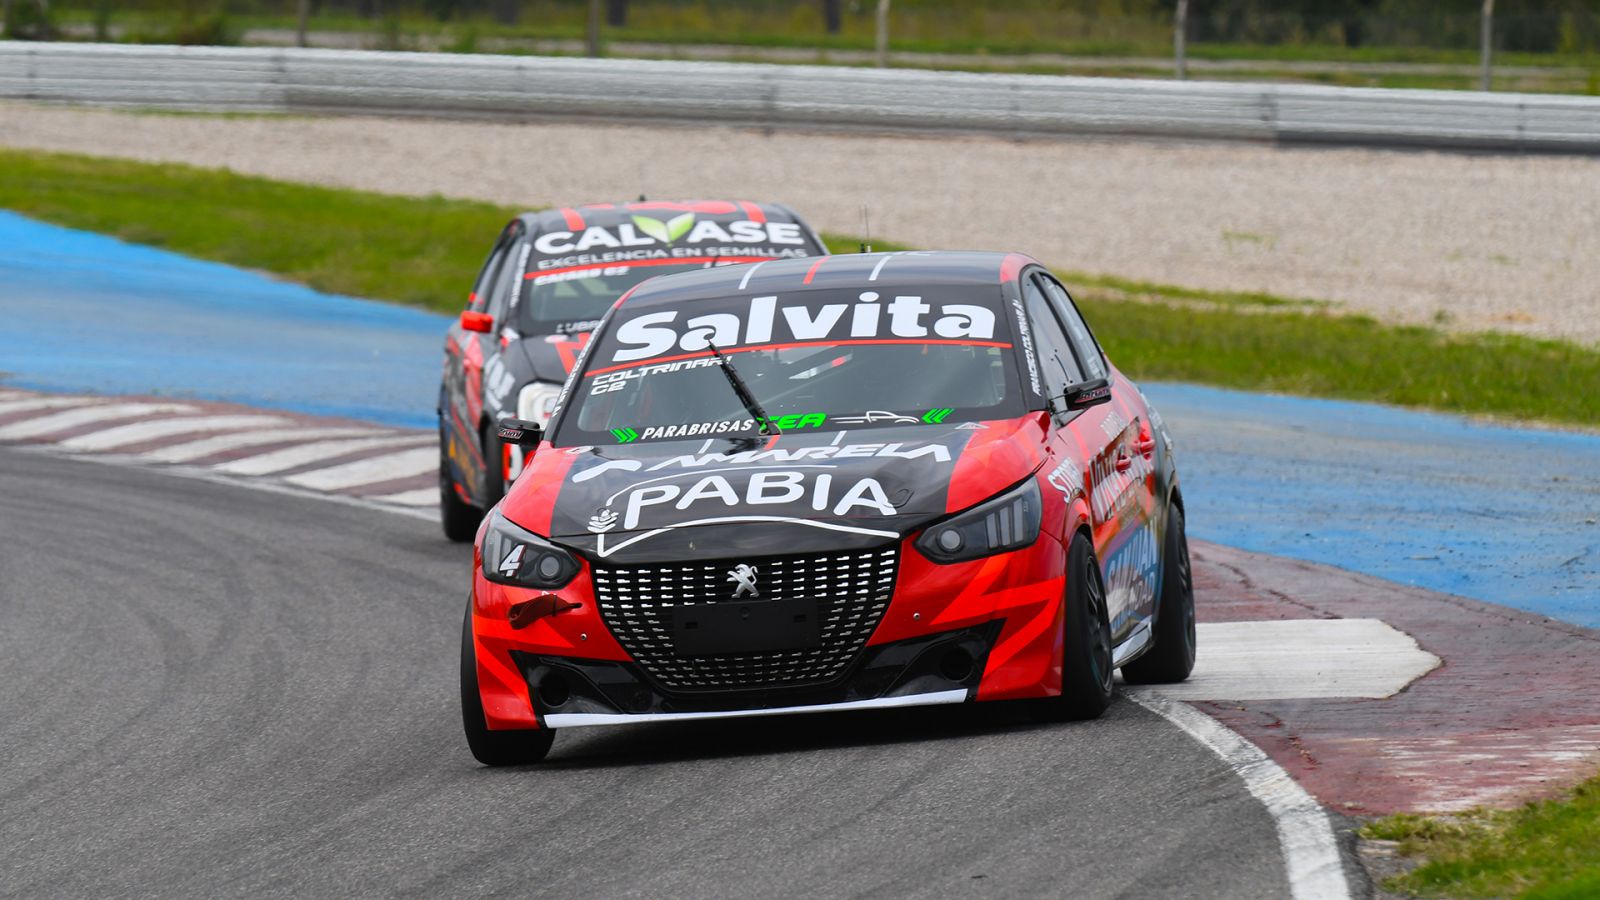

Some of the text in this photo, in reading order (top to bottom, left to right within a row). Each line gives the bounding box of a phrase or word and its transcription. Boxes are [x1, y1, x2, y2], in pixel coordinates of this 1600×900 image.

[535, 212, 804, 254] CALVASE
[537, 247, 807, 271] EXCELENCIA EN SEMILLAS
[613, 292, 996, 361] Salvita
[590, 380, 627, 396] C2
[641, 419, 754, 440] PARABRISAS
[624, 472, 897, 529] PABIA
[498, 543, 526, 577] 4
